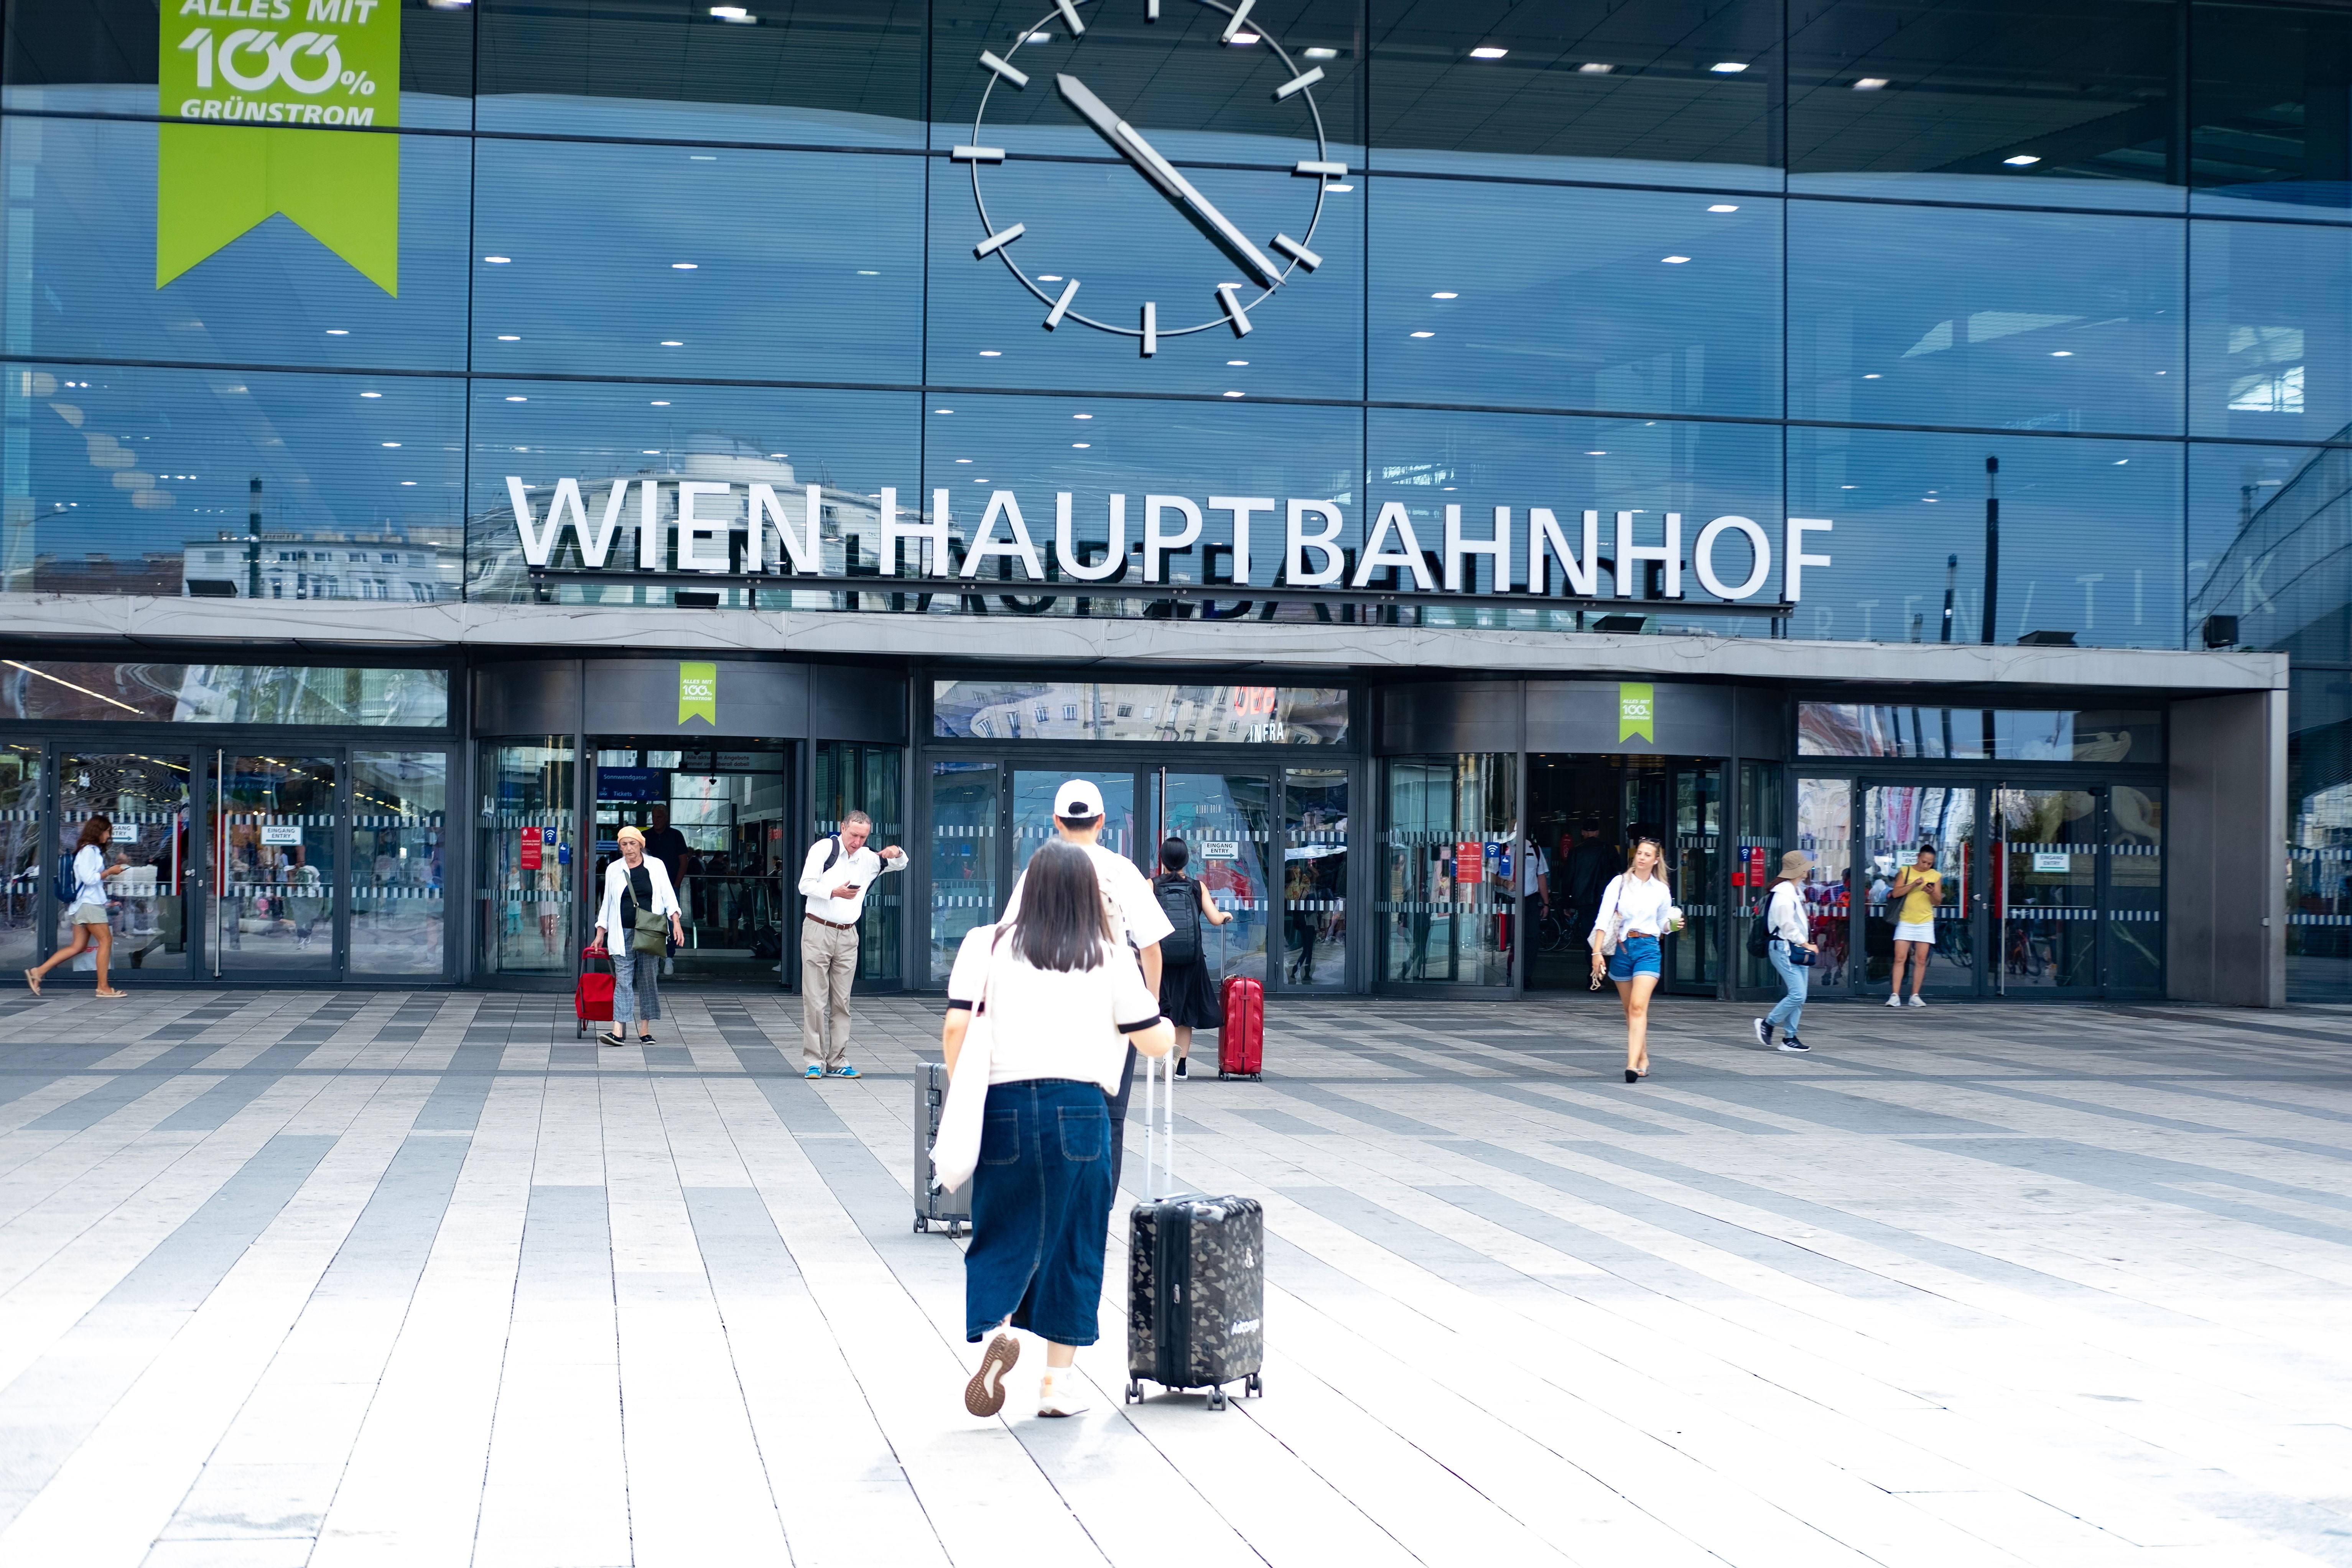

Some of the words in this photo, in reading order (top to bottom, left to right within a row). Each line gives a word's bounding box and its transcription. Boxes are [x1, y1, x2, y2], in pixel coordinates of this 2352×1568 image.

[179, 0, 291, 20] ALLES
[306, 0, 378, 23] MIT
[178, 28, 375, 95] 100%
[181, 96, 374, 126] GRÜNSTROM
[505, 476, 821, 573] WIEN
[880, 487, 1832, 602] HAUPTBAHNHOF
[683, 685, 712, 696] 100%
[1622, 704, 1651, 715] 100%
[1249, 722, 1284, 743] INFRA
